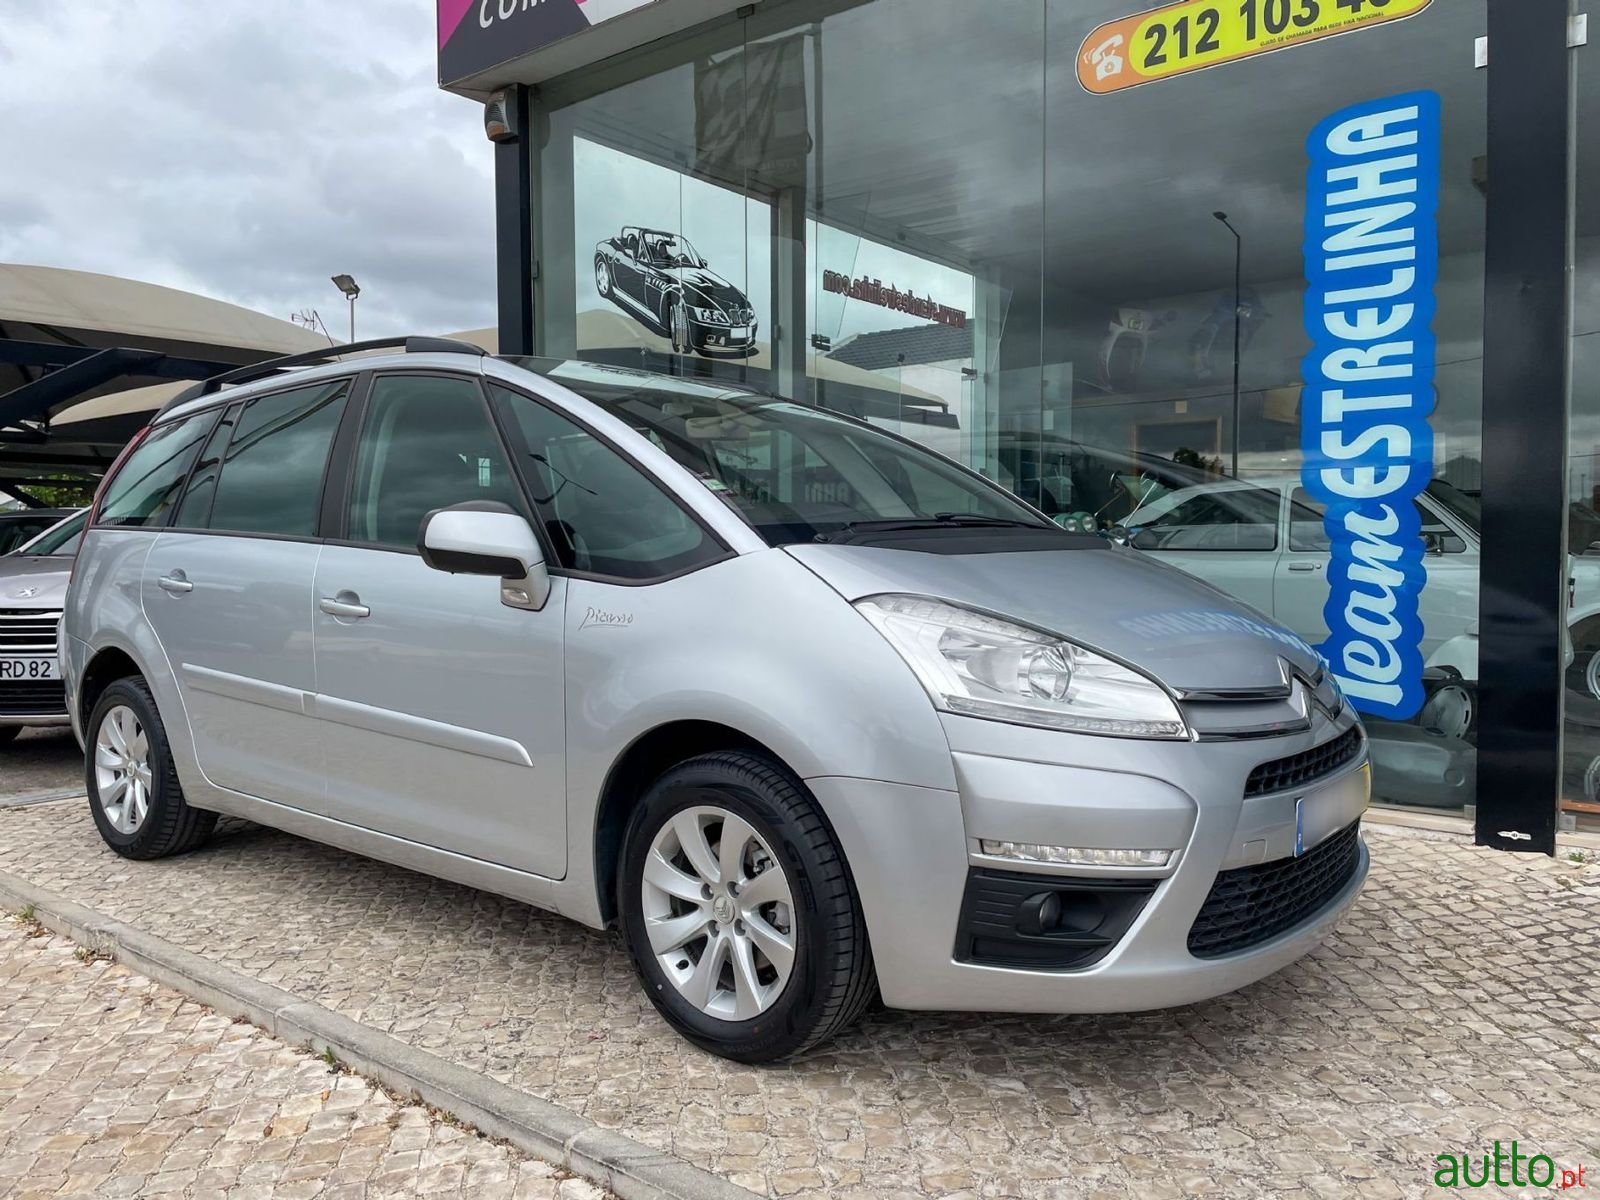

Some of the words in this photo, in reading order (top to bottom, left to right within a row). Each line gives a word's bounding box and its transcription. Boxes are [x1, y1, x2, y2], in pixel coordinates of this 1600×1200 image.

[1144, 8, 1220, 69] 212
[1239, 0, 1320, 41] 103
[1320, 105, 1419, 499] ESTRELINHA
[29, 660, 51, 679] 82
